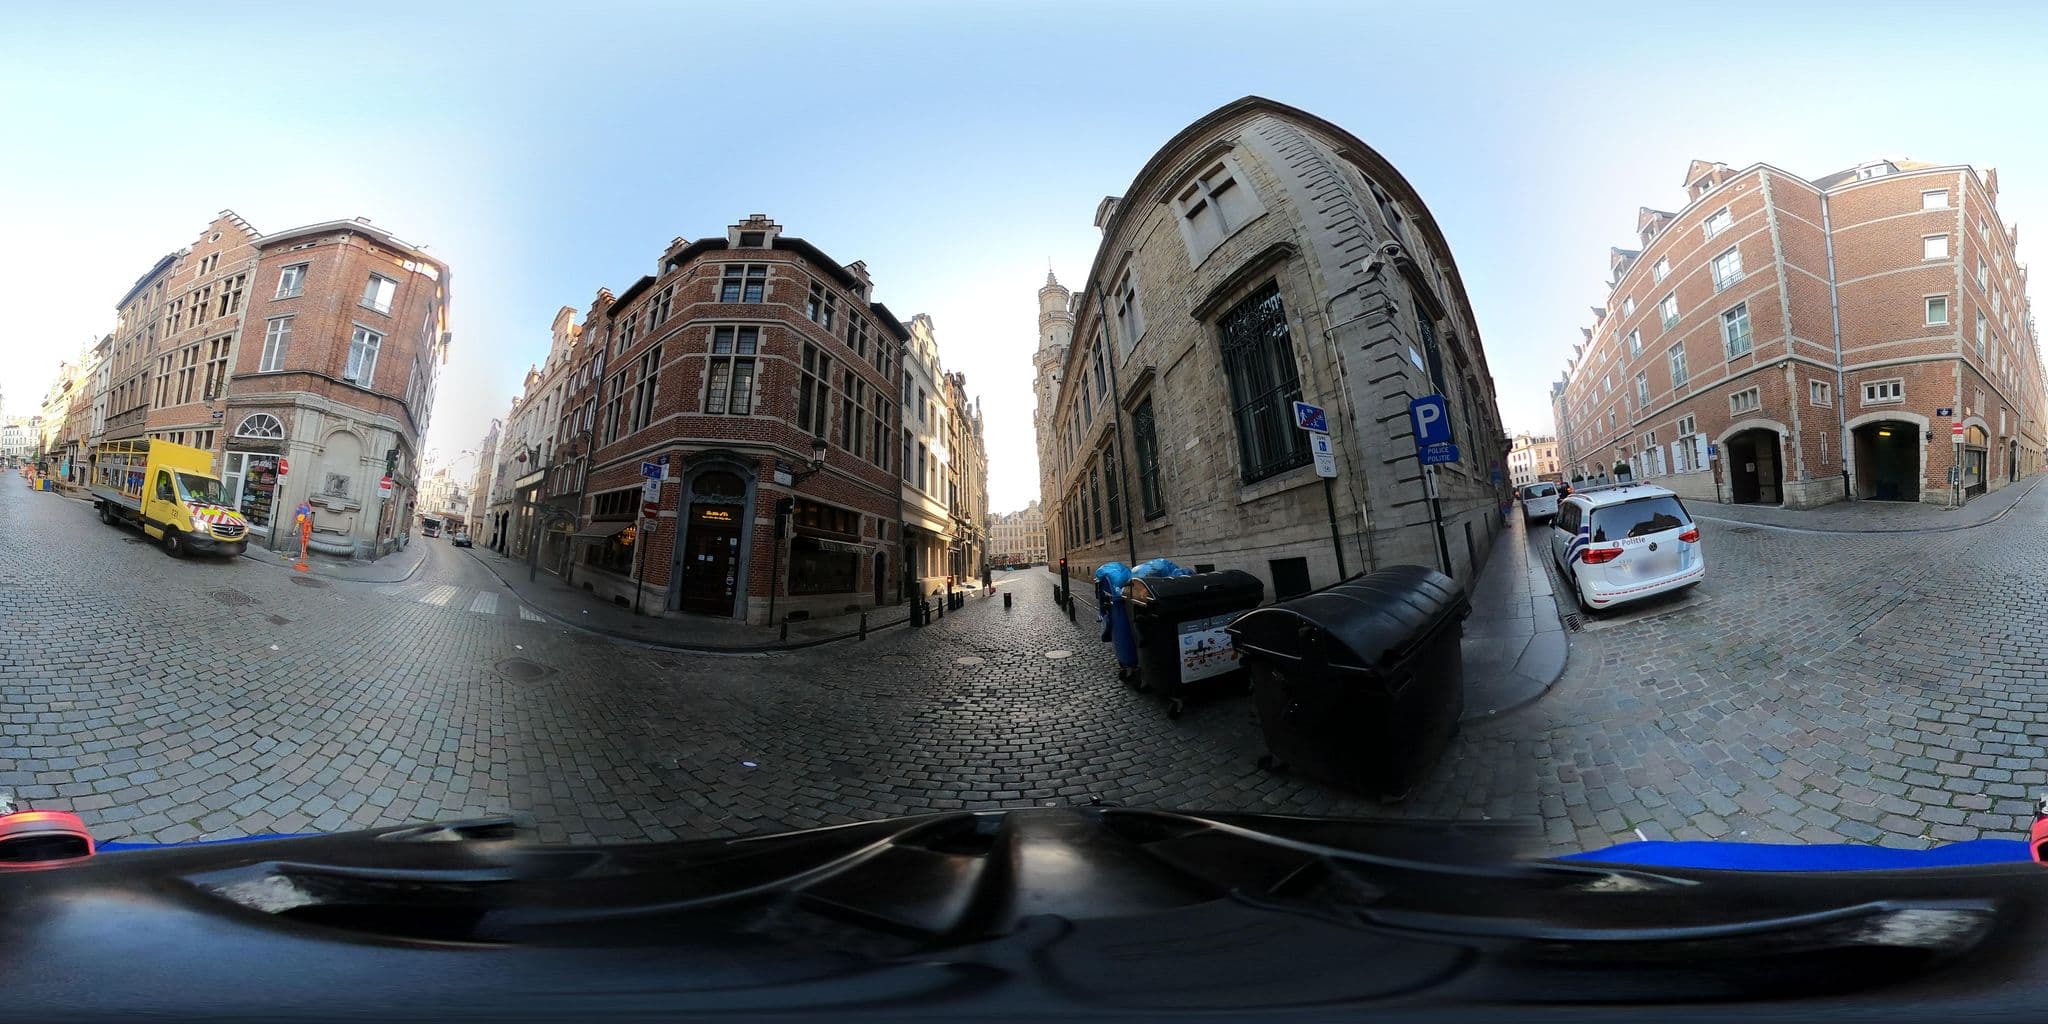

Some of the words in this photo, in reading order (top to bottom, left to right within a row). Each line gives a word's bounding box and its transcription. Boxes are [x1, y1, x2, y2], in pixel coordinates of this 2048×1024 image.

[1416, 403, 1440, 438] P
[1427, 447, 1449, 455] POLICE
[1427, 455, 1450, 463] POLITIE
[1621, 536, 1646, 547] Politie
